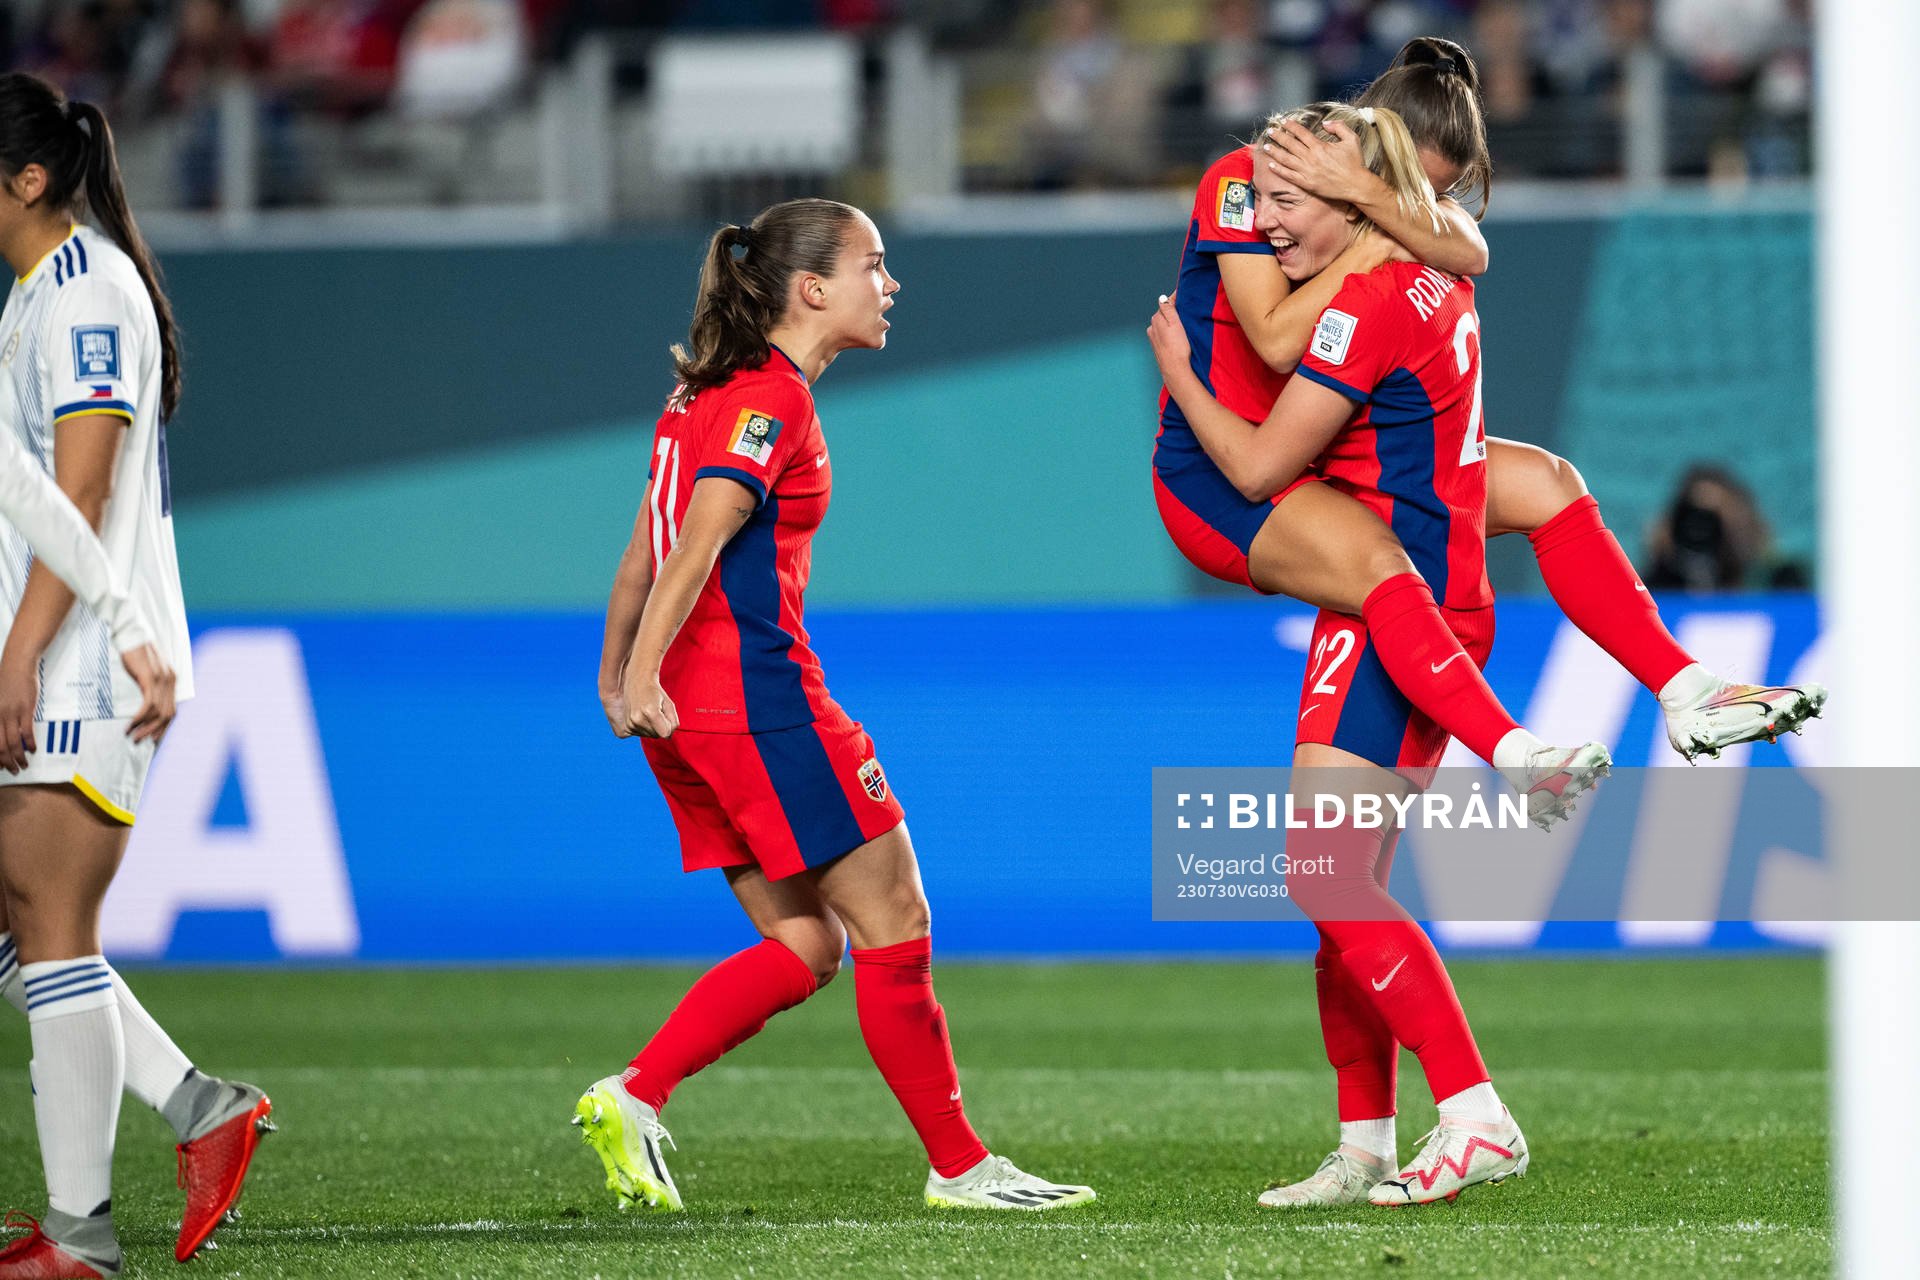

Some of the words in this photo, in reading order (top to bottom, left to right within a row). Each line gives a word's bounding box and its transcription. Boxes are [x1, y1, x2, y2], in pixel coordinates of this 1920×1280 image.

[1405, 265, 1455, 322] ROM
[1453, 311, 1487, 467] 2
[1309, 629, 1356, 695] 22
